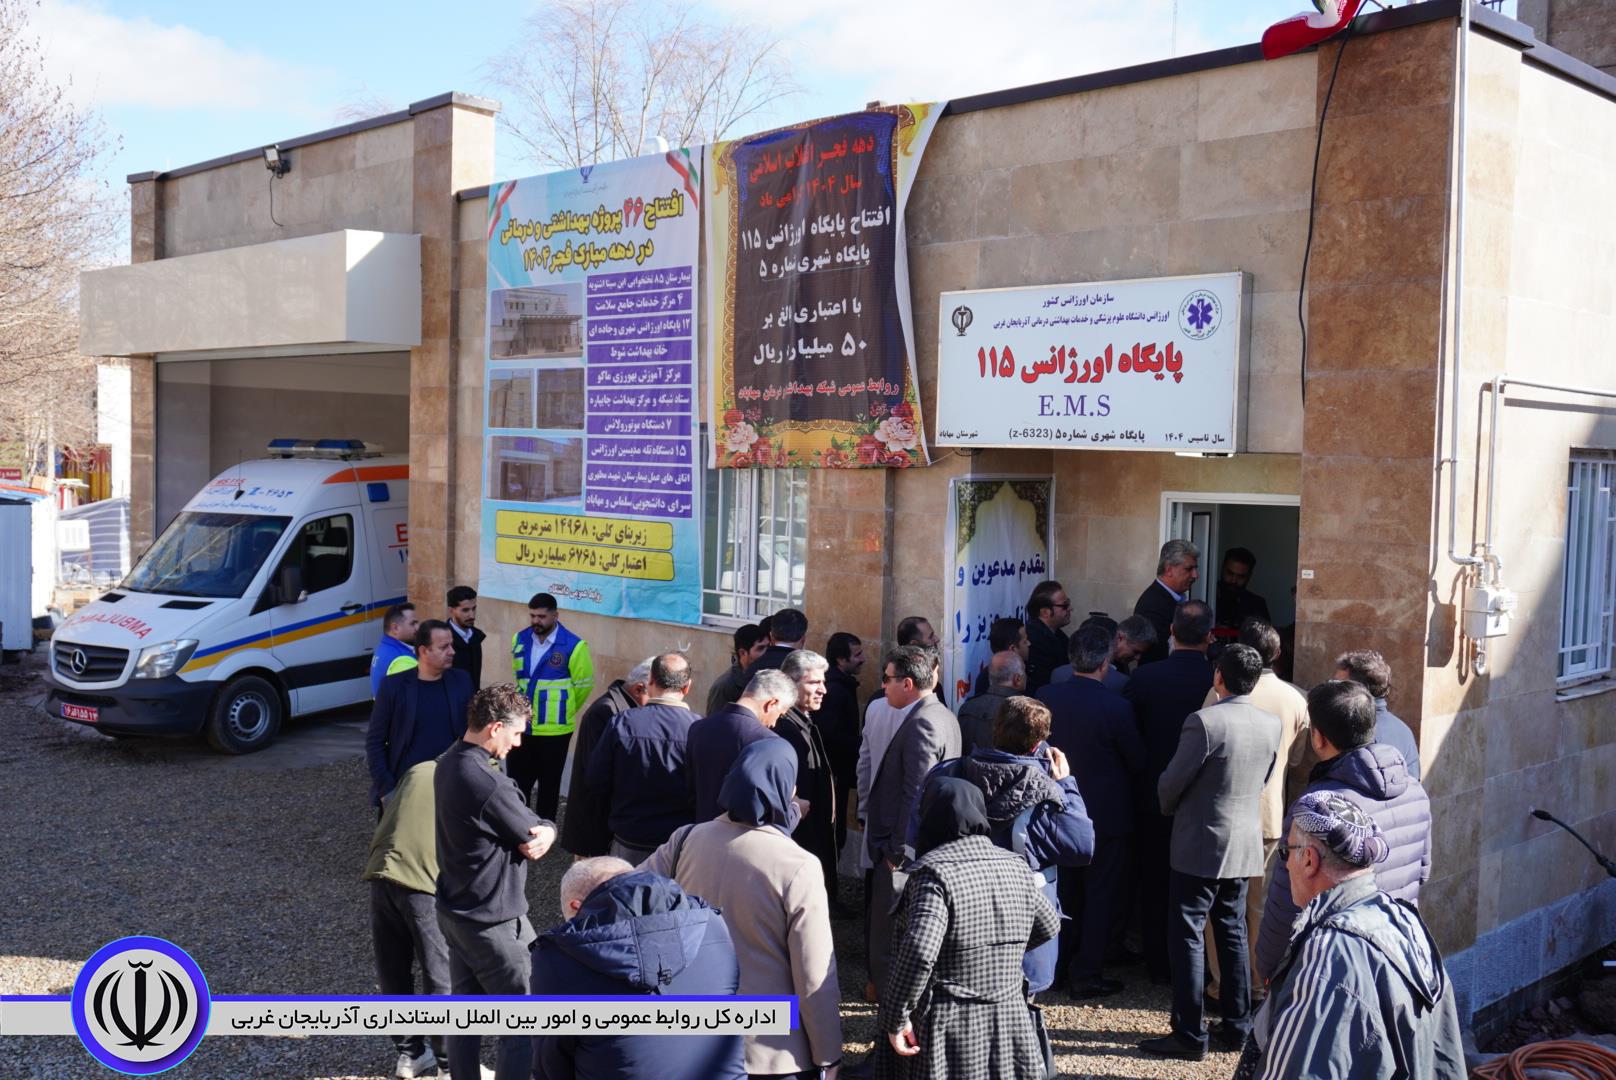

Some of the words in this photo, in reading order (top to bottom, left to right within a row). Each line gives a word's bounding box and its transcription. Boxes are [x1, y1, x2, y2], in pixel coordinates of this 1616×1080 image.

[816, 134, 848, 168] فجر
[841, 175, 862, 194] سال
[644, 188, 684, 230] افتتاح
[542, 209, 591, 240] بهداشتی
[591, 204, 622, 235] پروژه
[810, 212, 845, 239] پایگاه
[850, 205, 891, 234] افتتاح
[501, 218, 534, 245] درمانی
[535, 221, 541, 242] و
[766, 218, 806, 250] اورژانس
[742, 228, 761, 250] ۱۱۵
[549, 239, 572, 273] فجر
[573, 241, 607, 271] مبارک
[608, 240, 635, 261] دهه
[636, 238, 654, 265] در
[836, 243, 870, 265] پایگاه
[524, 245, 550, 272] ۱۴۰۴
[798, 248, 831, 272] شهری
[759, 259, 767, 277] ۵
[605, 280, 616, 290] سینا
[617, 278, 626, 289] ابن
[654, 274, 664, 284] ۸۵
[666, 272, 691, 285] بیمارستان
[617, 298, 634, 312] جامع
[636, 297, 659, 308] خدمات
[661, 295, 676, 309] مرکز
[677, 293, 683, 304] ۴
[1043, 296, 1059, 308] کشور
[1061, 294, 1088, 306] اورژانس
[1090, 293, 1114, 305] سازمان
[595, 300, 616, 311] سلامت
[794, 298, 847, 323] اعتباری
[852, 297, 862, 318] با
[761, 313, 773, 329] بر
[1007, 316, 1030, 328] آذربایجان
[1031, 317, 1048, 327] درمانی
[1050, 316, 1070, 326] بهداشتی
[1071, 315, 1088, 323] خدمات
[1094, 314, 1111, 324] پزشکی
[1113, 313, 1124, 324] علوم
[1126, 312, 1146, 321] دانشگاه
[1147, 310, 1170, 322] اورژانس
[618, 323, 636, 336] شهری
[637, 321, 662, 334] اورژانس
[663, 320, 681, 332] پایگاه
[993, 319, 1006, 329] غربی
[588, 325, 597, 337] ای
[654, 344, 668, 355] خانه
[841, 332, 867, 356] ۵۰
[610, 346, 626, 360] شوط
[627, 346, 652, 358] بهداشت
[754, 343, 783, 365] ریال
[977, 345, 1015, 378] ۱۱۵
[1021, 343, 1113, 383] اورژانس
[1118, 341, 1184, 384] پایگاه
[597, 370, 611, 384] ماکو
[612, 371, 637, 384] بهورزی
[638, 367, 663, 383] آموزش
[665, 368, 681, 382] مرکز
[816, 380, 836, 396] شبکه
[867, 377, 899, 396] روابط
[612, 394, 636, 406] بهداشت
[637, 395, 650, 407] مرکز
[658, 394, 673, 406] شبکه
[674, 393, 690, 404] ستاد
[1038, 394, 1111, 417] E.M.S
[641, 419, 665, 430] دستگاه
[666, 418, 672, 430] ۷
[939, 430, 954, 438] مهاباد
[956, 430, 978, 439] شهرستان
[1009, 428, 1053, 440] (z-6323)
[1091, 430, 1116, 442] شهری
[1120, 430, 1145, 443] پایگاه
[1165, 432, 1183, 441] ۱۴۰۴
[1188, 434, 1209, 444] تاسیس
[1212, 434, 1225, 444] سال
[591, 443, 617, 456] اورژانس
[618, 446, 641, 457] مدیسین
[642, 445, 652, 455] تله
[652, 445, 674, 456] دستگاه
[676, 445, 686, 456] ۱۵
[588, 470, 608, 481] مطهری
[608, 471, 621, 481] شهید
[621, 471, 648, 483] بیمارستان
[647, 472, 660, 483] عمل
[661, 473, 673, 484] های
[674, 473, 690, 484] اتاق
[586, 494, 604, 507] مهاباد
[610, 496, 632, 508] سلماس
[632, 498, 666, 511] دانشجویی
[667, 500, 691, 513] سرای
[555, 518, 588, 536] ۱۴۹۶۸
[592, 523, 613, 541] کلی:
[615, 525, 647, 546] زیربنای
[515, 543, 535, 562] ریال
[538, 546, 566, 565] میلیارد
[568, 547, 596, 566] ۶۷۶۵
[599, 552, 620, 571] کلی:
[620, 554, 646, 573] اعتبار
[1020, 553, 1045, 582] مقدم
[956, 566, 964, 586] و
[972, 560, 1015, 586] مدعوین
[956, 609, 970, 643] را
